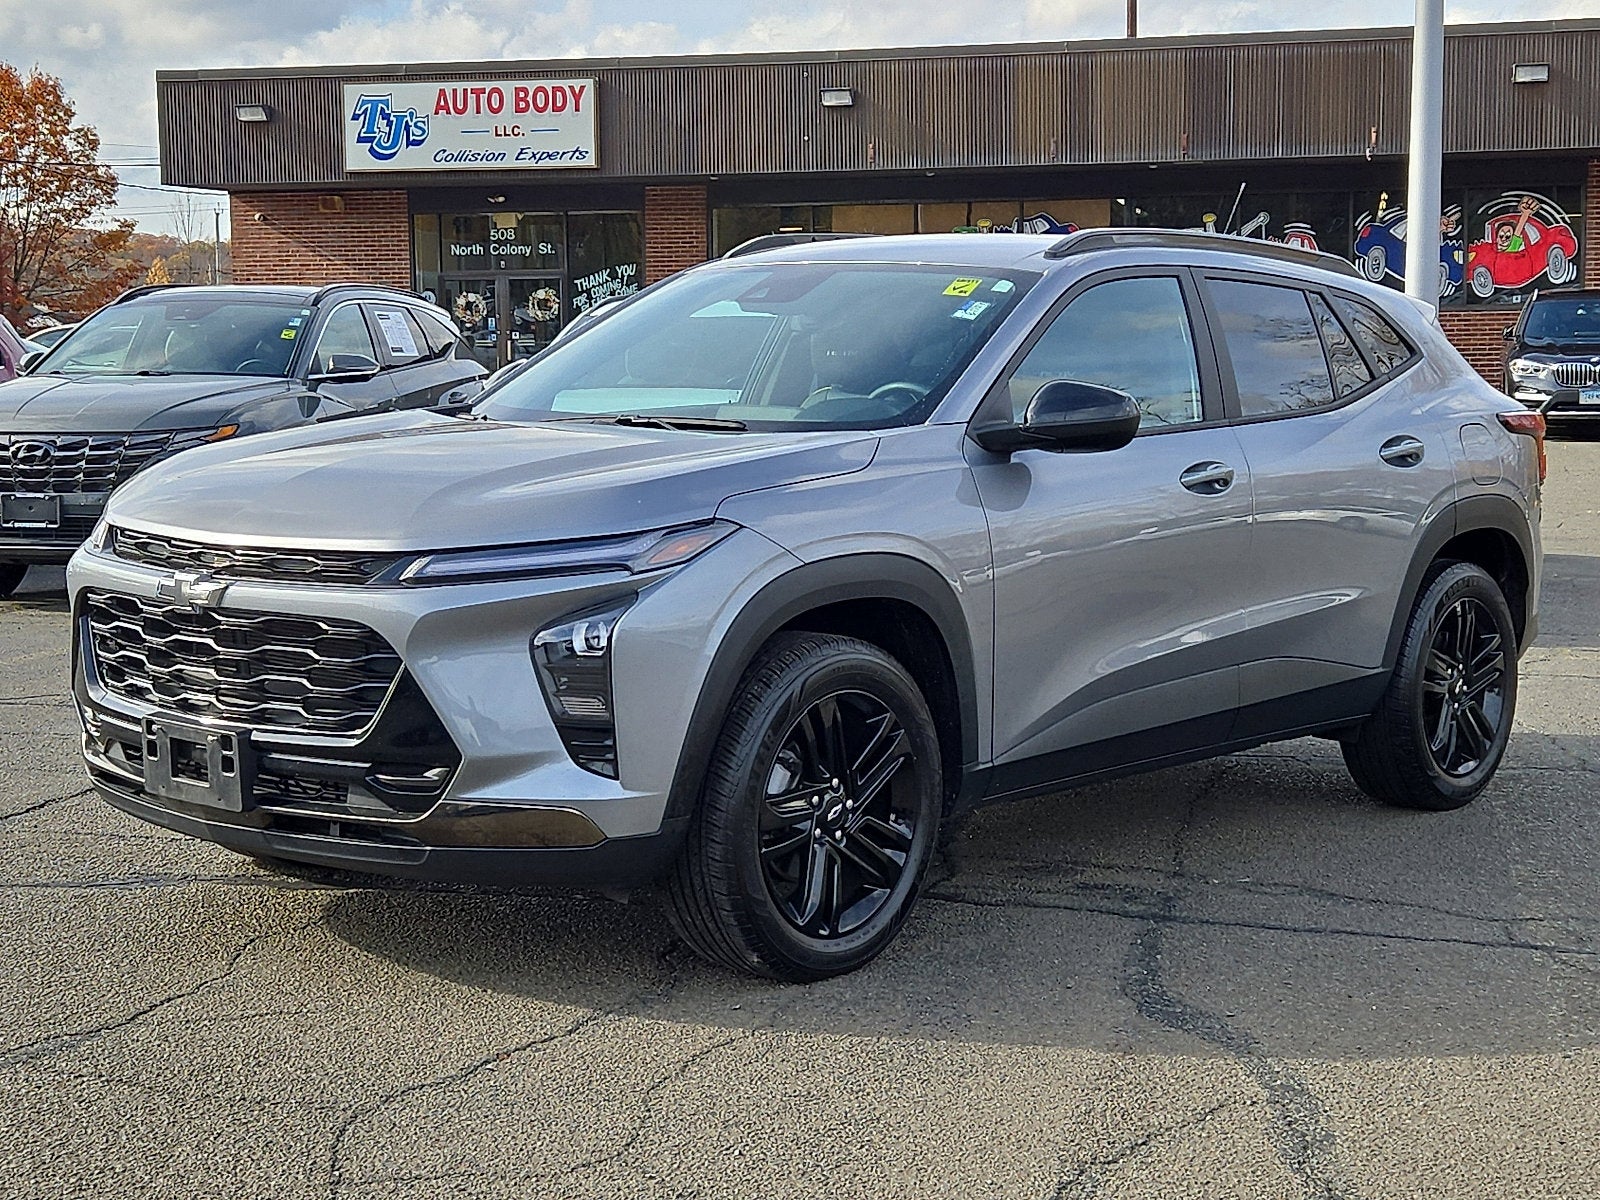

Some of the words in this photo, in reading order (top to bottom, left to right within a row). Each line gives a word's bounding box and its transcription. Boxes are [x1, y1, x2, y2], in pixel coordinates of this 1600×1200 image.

[434, 87, 504, 115] AUTO
[514, 85, 586, 114] BODY
[350, 92, 430, 161] TJ's
[494, 125, 526, 137] LLC.
[433, 149, 506, 163] Collision
[514, 146, 589, 165] Experts
[490, 229, 515, 240] 508
[450, 244, 484, 256] North
[489, 243, 532, 257] Colony
[538, 242, 556, 254] St.
[573, 268, 612, 292] THANK
[615, 263, 637, 279] YOU
[572, 292, 590, 309] FOR
